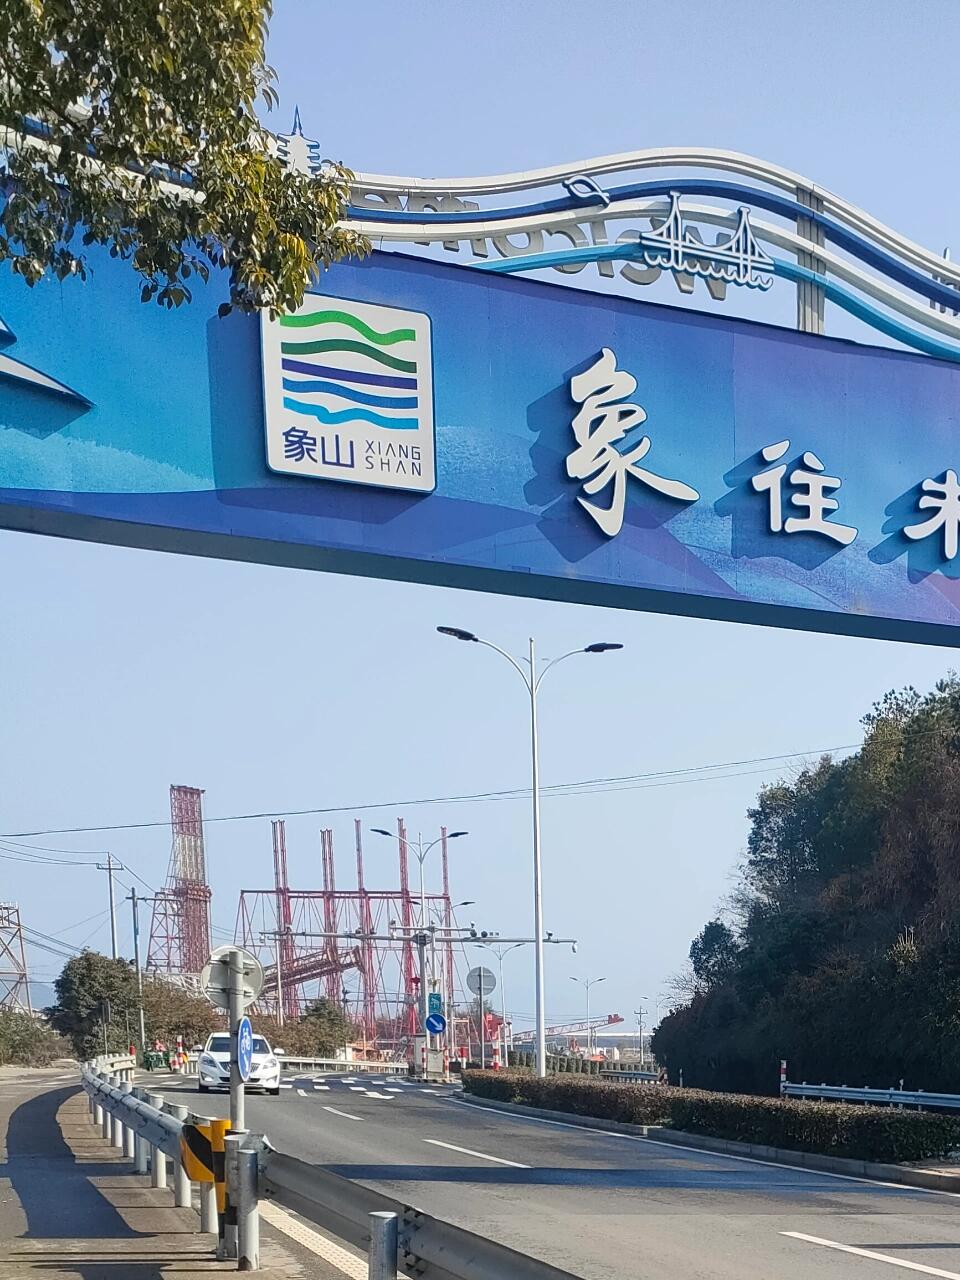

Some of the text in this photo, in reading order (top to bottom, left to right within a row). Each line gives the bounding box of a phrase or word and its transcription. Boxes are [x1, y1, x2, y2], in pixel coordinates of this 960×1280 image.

[282, 426, 355, 469] 象山
[365, 440, 421, 461] XIANG
[365, 455, 422, 477] SHAN
